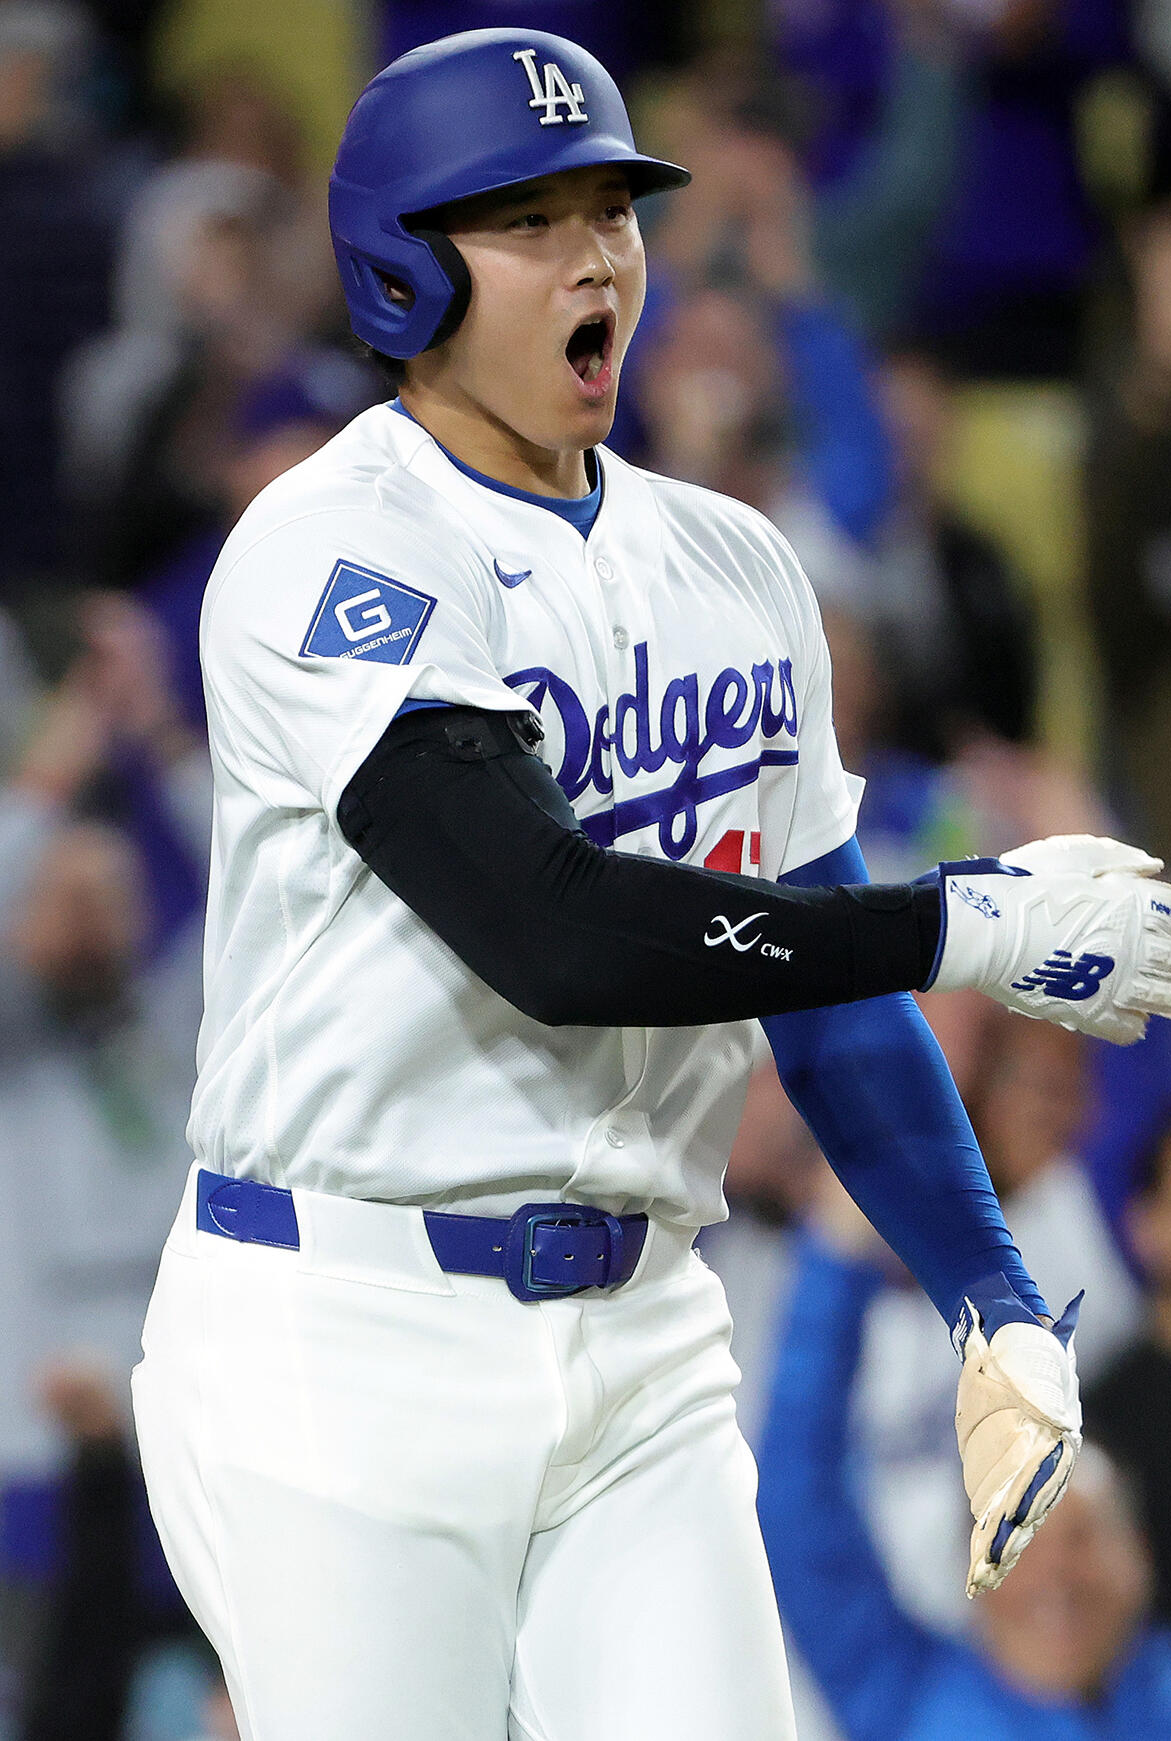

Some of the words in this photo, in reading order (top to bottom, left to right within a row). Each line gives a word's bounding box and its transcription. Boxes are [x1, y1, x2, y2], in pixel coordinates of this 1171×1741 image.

[513, 48, 589, 126] LA
[334, 587, 392, 642] G
[760, 943, 794, 962] CW-X
